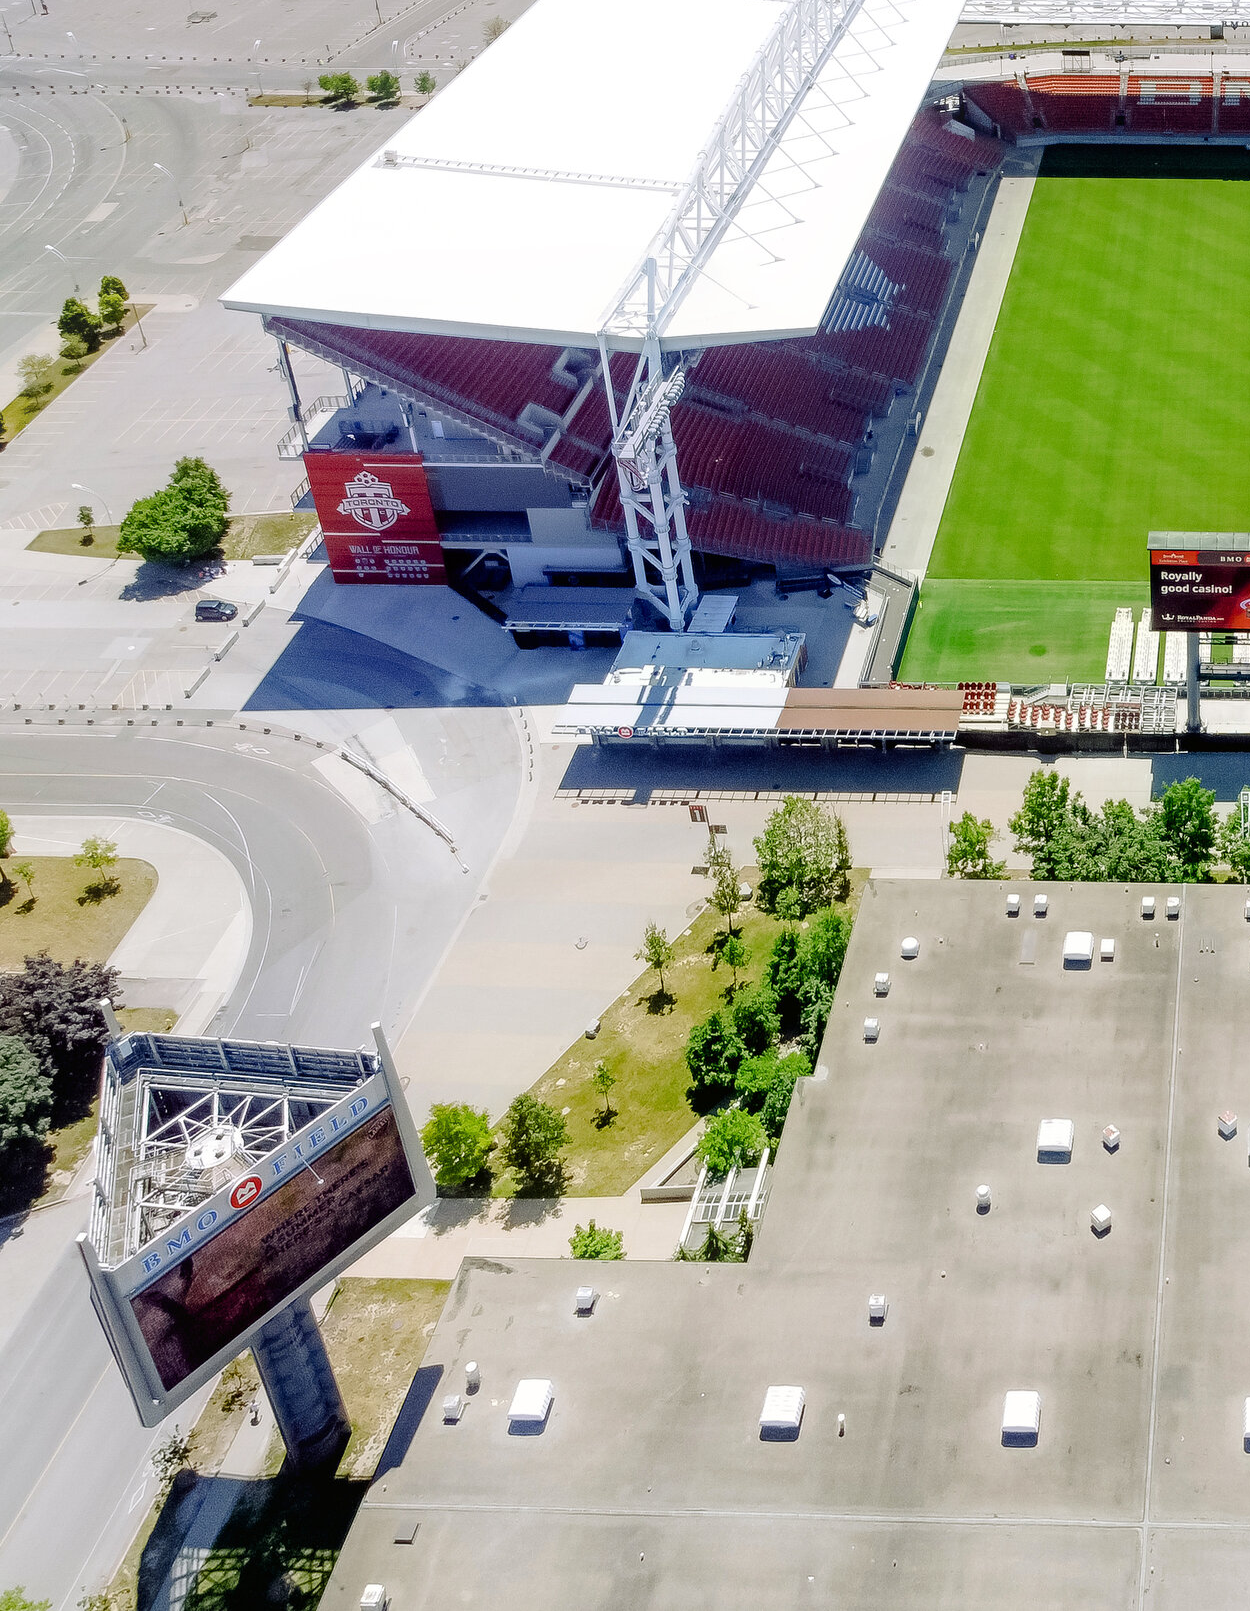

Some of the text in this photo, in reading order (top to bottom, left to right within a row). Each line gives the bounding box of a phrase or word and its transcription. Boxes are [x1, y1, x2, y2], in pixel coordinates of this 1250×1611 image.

[346, 499, 399, 507] TORONTO
[349, 545, 420, 554] WALL OF HONOUR
[1161, 571, 1202, 583] Royally
[1161, 584, 1233, 594] good casino!
[143, 1096, 369, 1274] BMO FIELD
[260, 1158, 370, 1245] WHERE THERE'S
[276, 1194, 337, 1243] SUMMER
